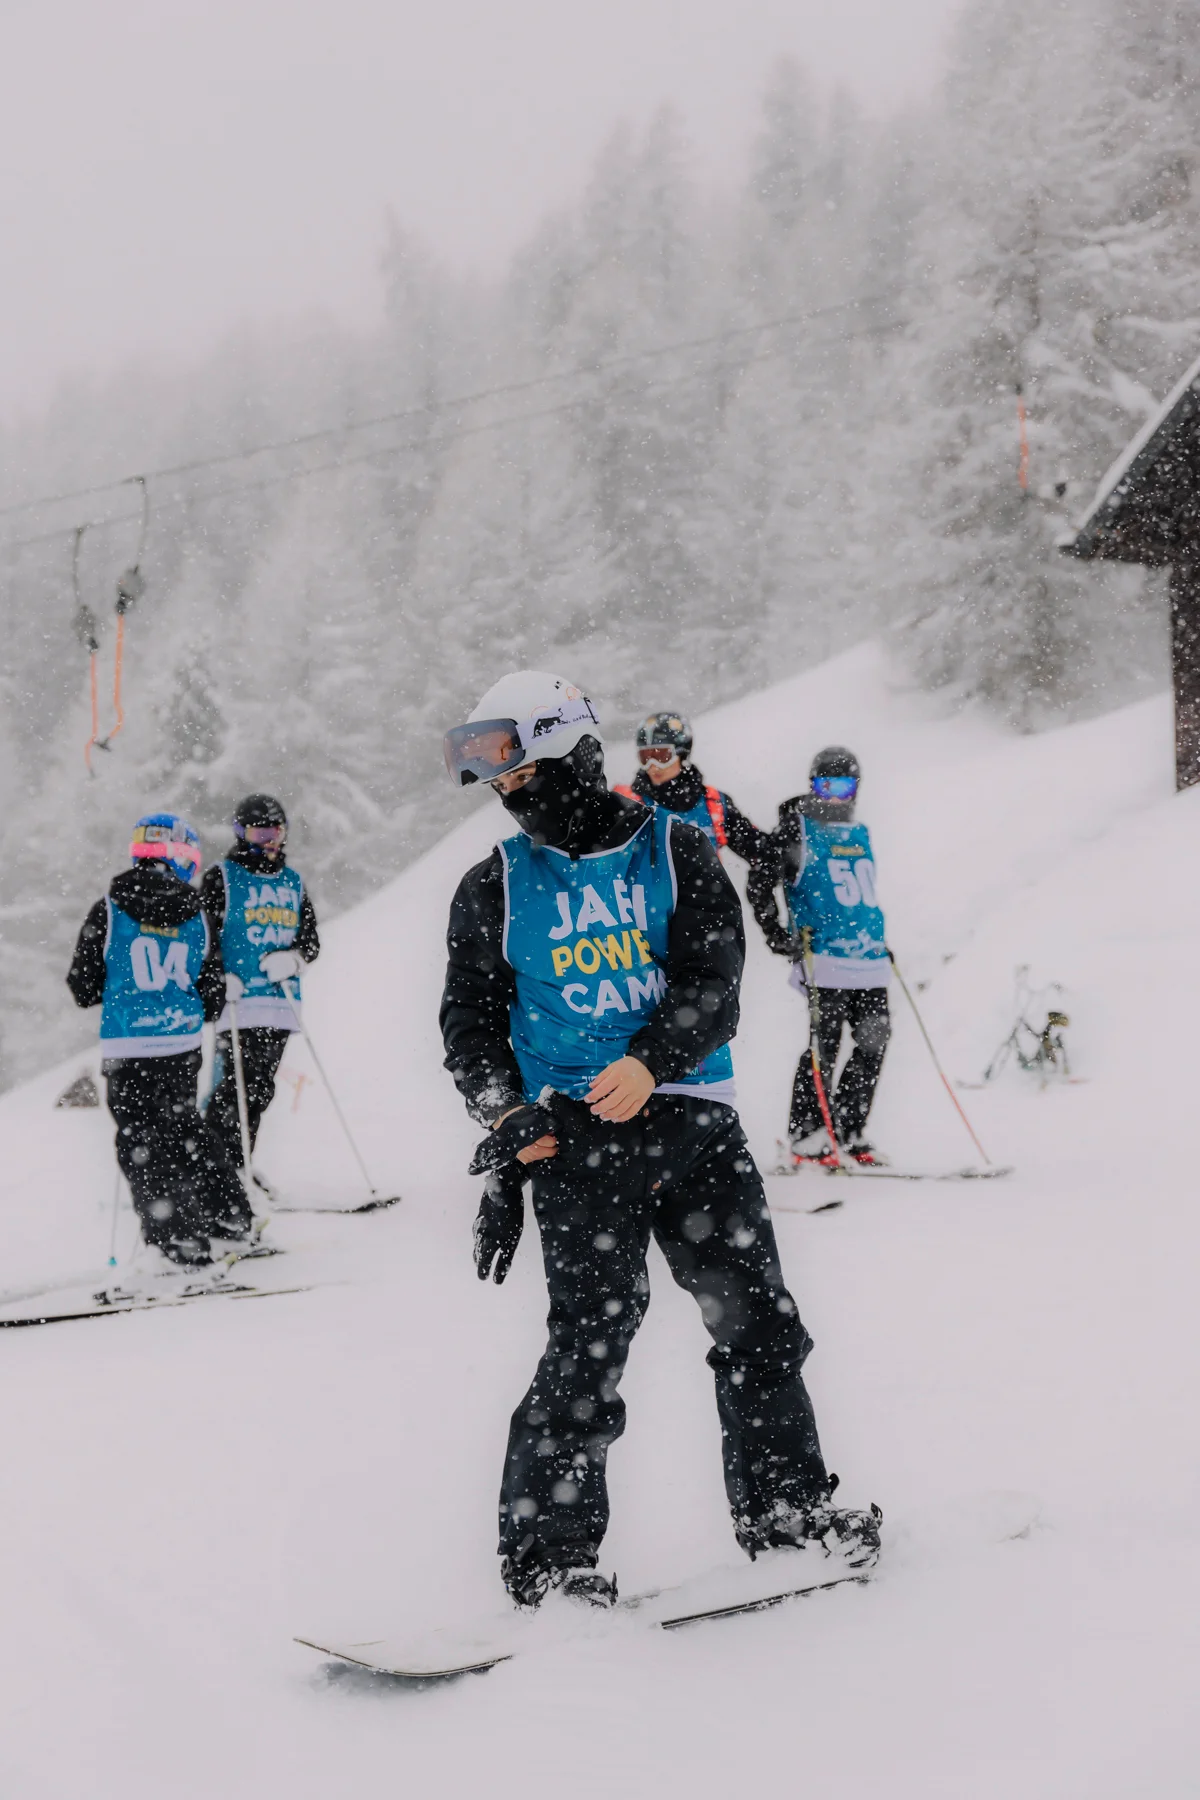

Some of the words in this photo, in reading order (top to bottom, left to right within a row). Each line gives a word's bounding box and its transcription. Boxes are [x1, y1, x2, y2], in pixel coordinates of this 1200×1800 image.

[827, 858, 877, 908] 50
[130, 936, 191, 991] 04
[551, 929, 653, 977] POWE
